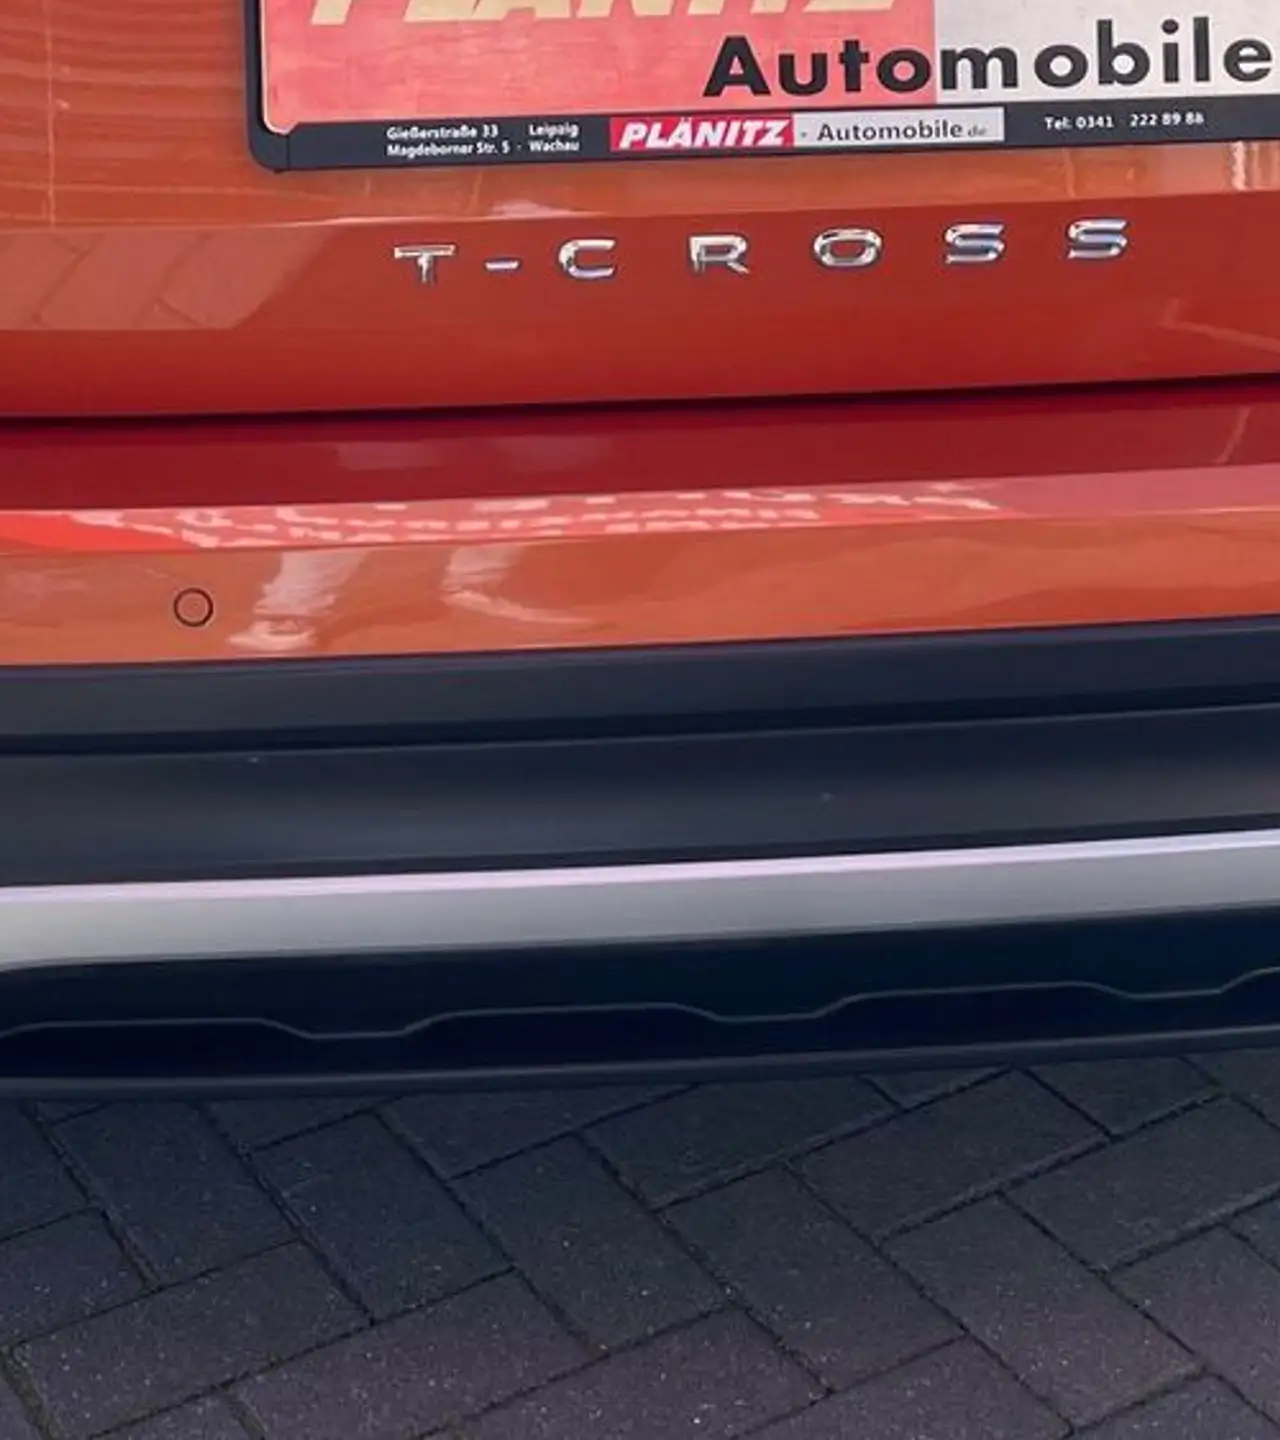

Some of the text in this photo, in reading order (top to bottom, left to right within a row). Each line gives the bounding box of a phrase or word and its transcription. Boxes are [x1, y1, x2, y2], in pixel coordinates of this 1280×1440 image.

[703, 16, 1273, 98] Automobile
[386, 122, 580, 140] Gießerstraße 33 Leipzig
[619, 116, 791, 149] PLÄNITZ
[1075, 115, 1114, 129] 0341
[1129, 113, 1158, 127] 222
[1161, 112, 1182, 126] 89
[476, 141, 498, 155] Str.
[528, 138, 580, 152] Wachau
[394, 218, 1128, 285] T-CROSS
